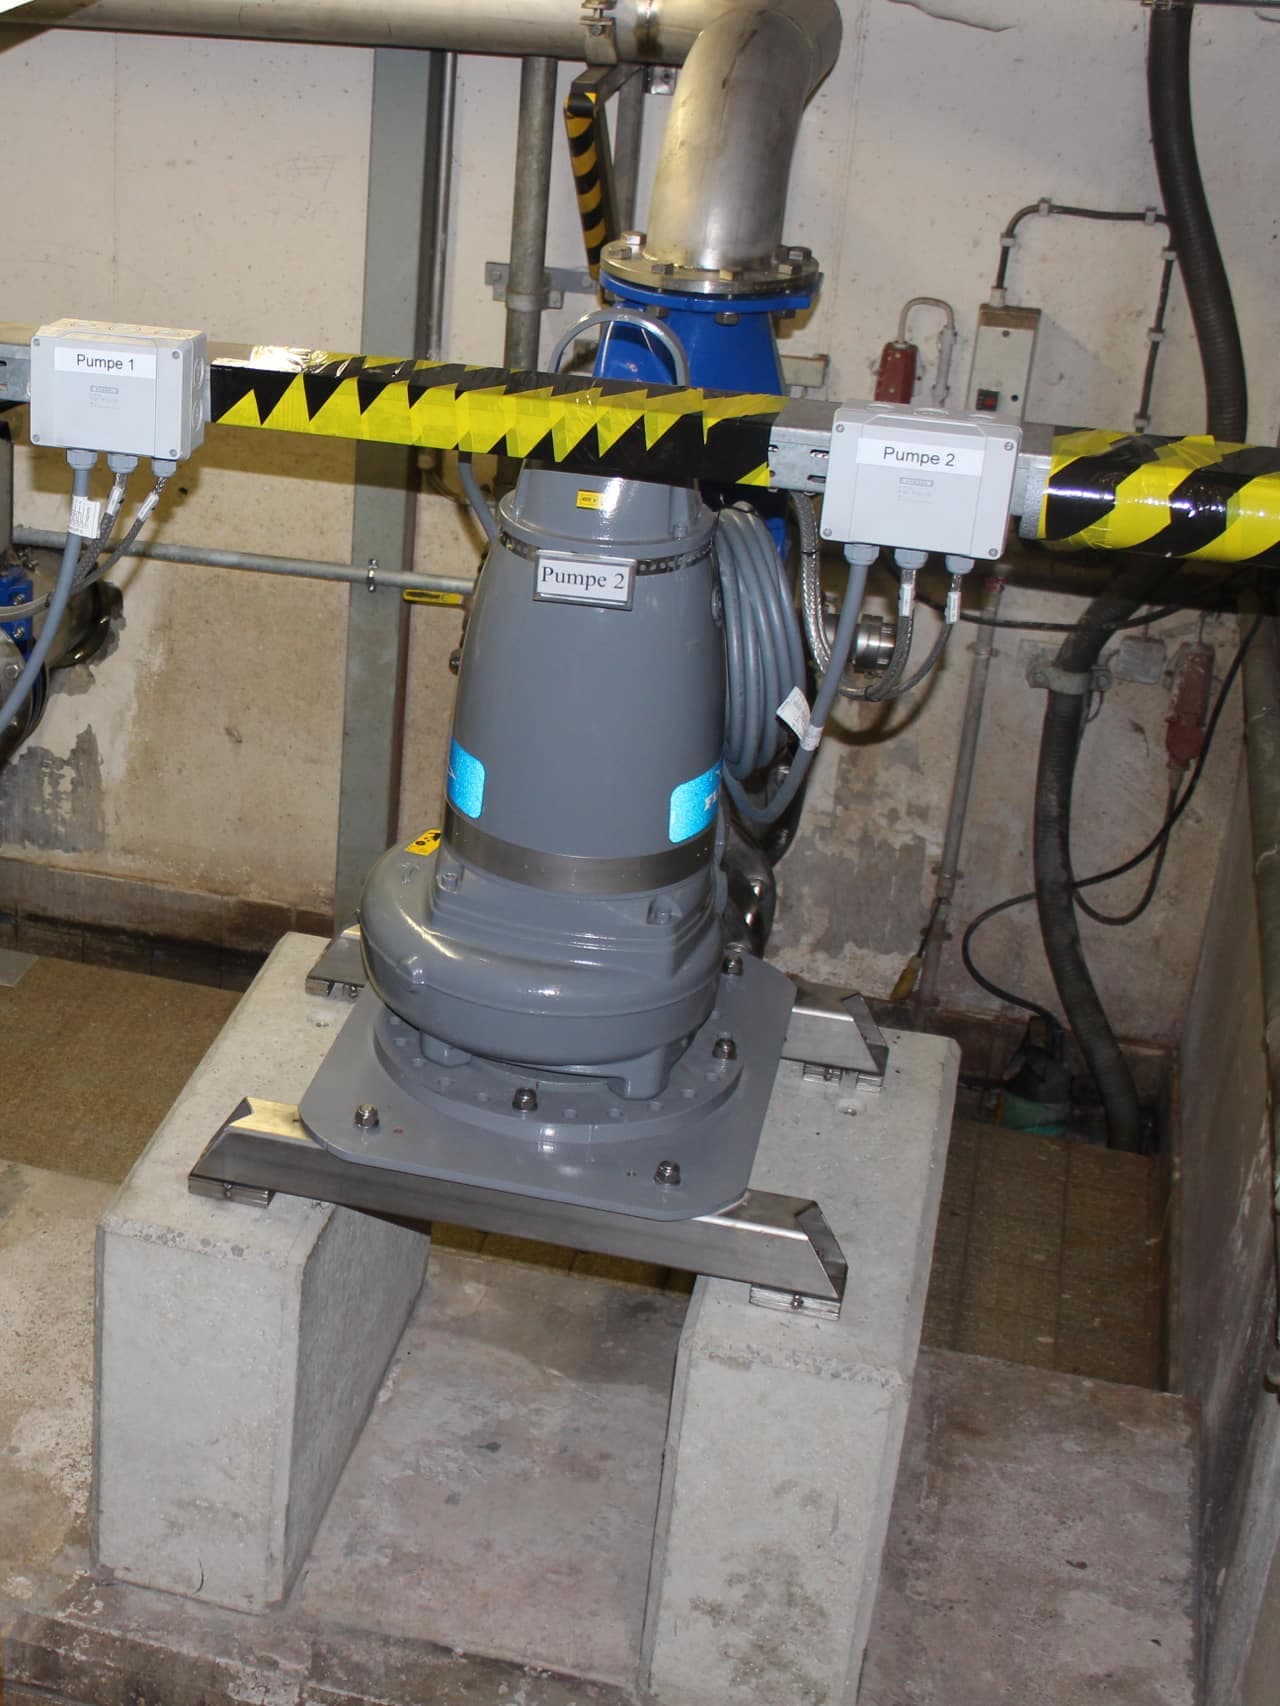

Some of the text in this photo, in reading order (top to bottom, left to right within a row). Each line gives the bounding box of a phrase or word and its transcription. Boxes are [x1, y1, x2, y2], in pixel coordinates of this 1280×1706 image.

[76, 353, 134, 372] Pumpe 1
[883, 446, 956, 467] Pumpe 2
[541, 566, 625, 591] Pumpe 2
